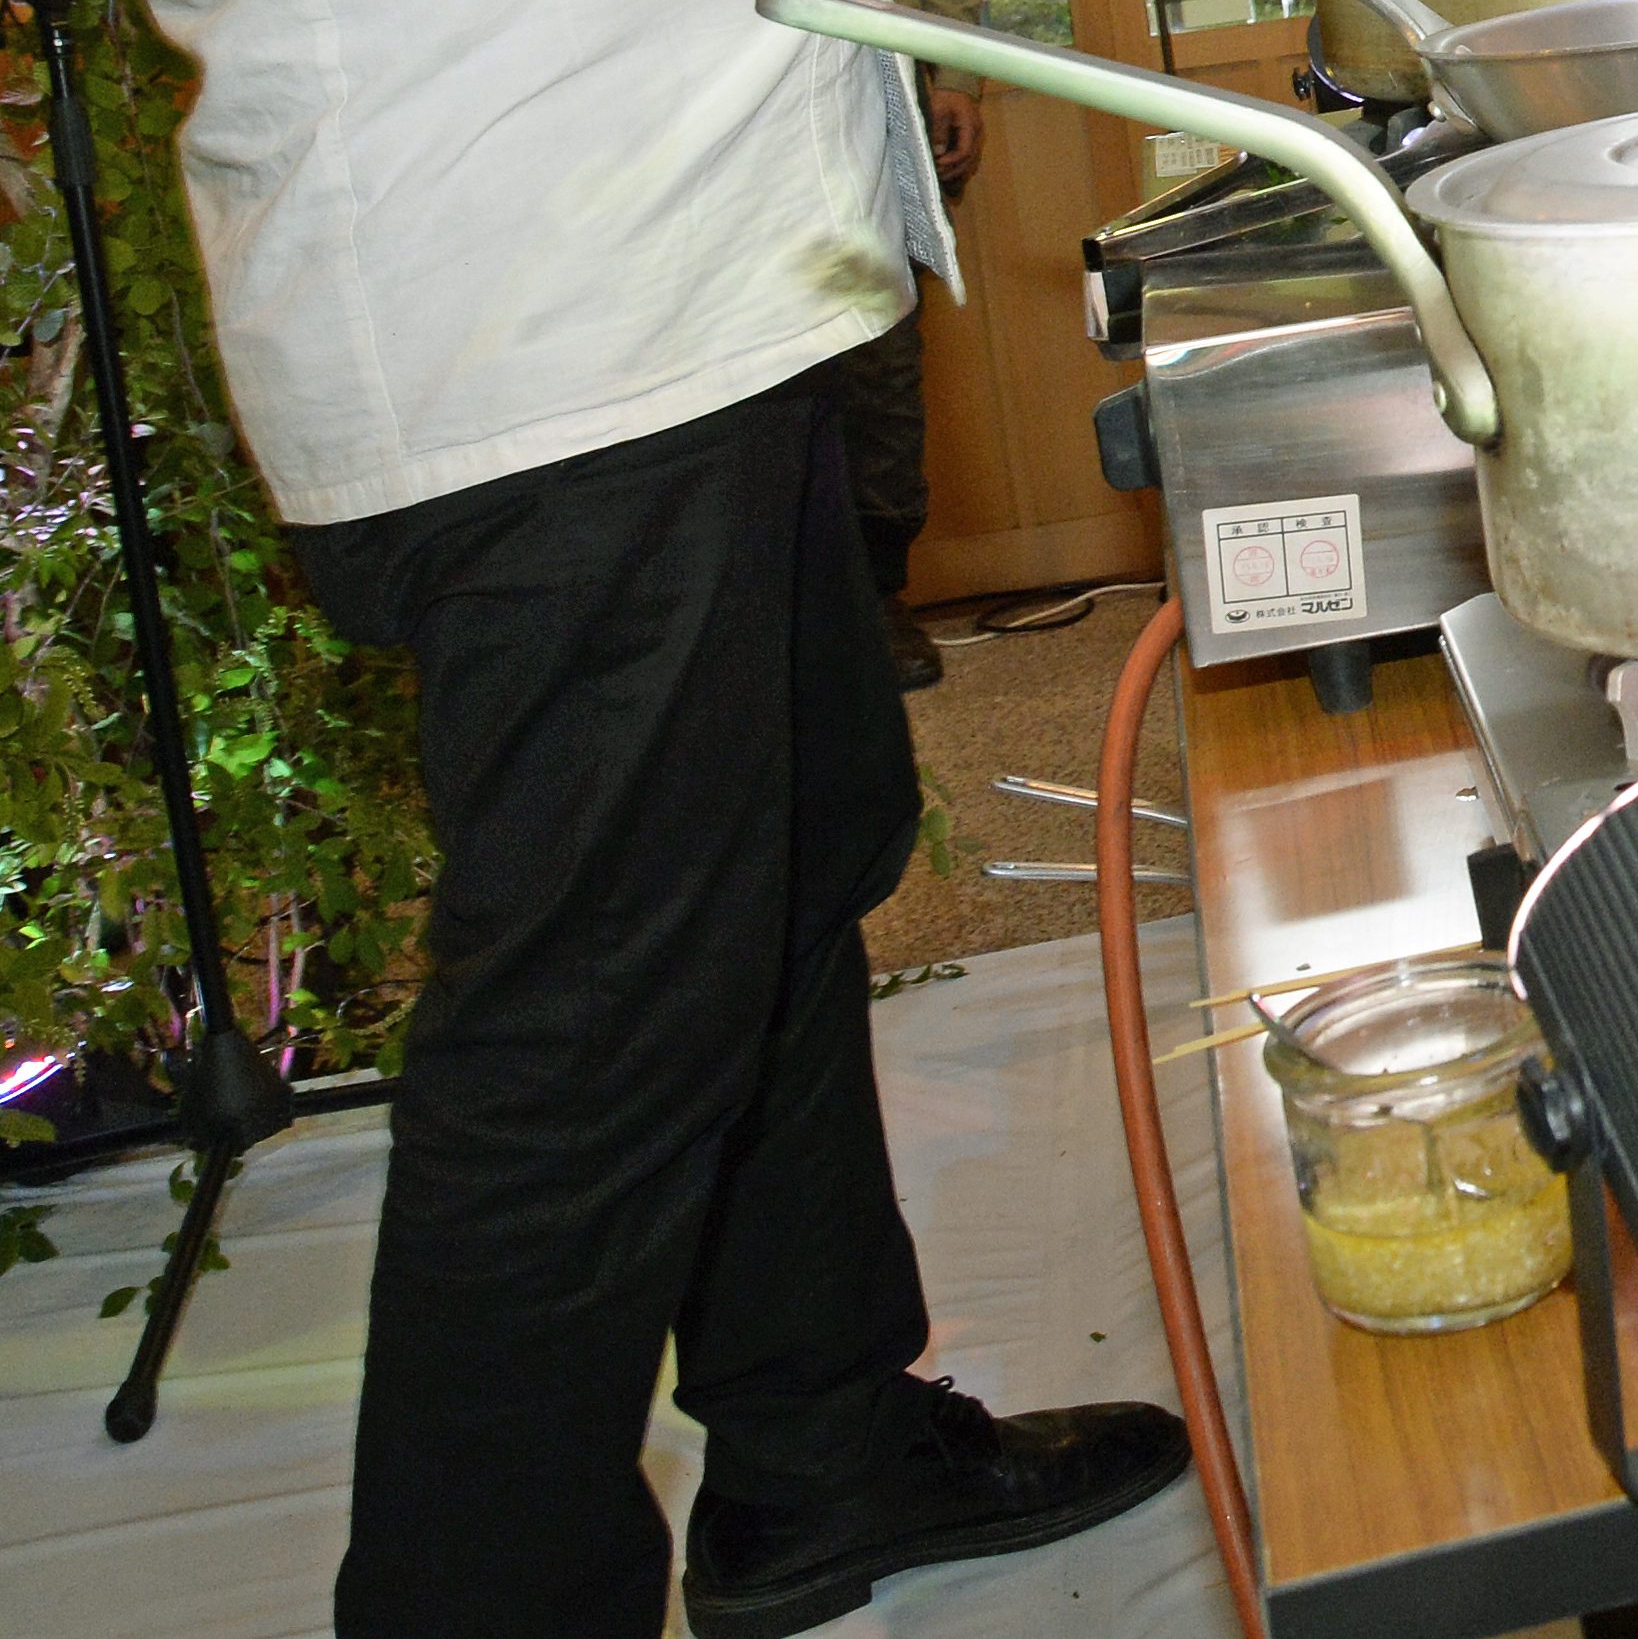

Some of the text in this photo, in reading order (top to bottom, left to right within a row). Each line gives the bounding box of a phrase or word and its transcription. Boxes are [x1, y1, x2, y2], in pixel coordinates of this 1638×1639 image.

[1255, 597, 1353, 619] 株式会社 マルゼン
